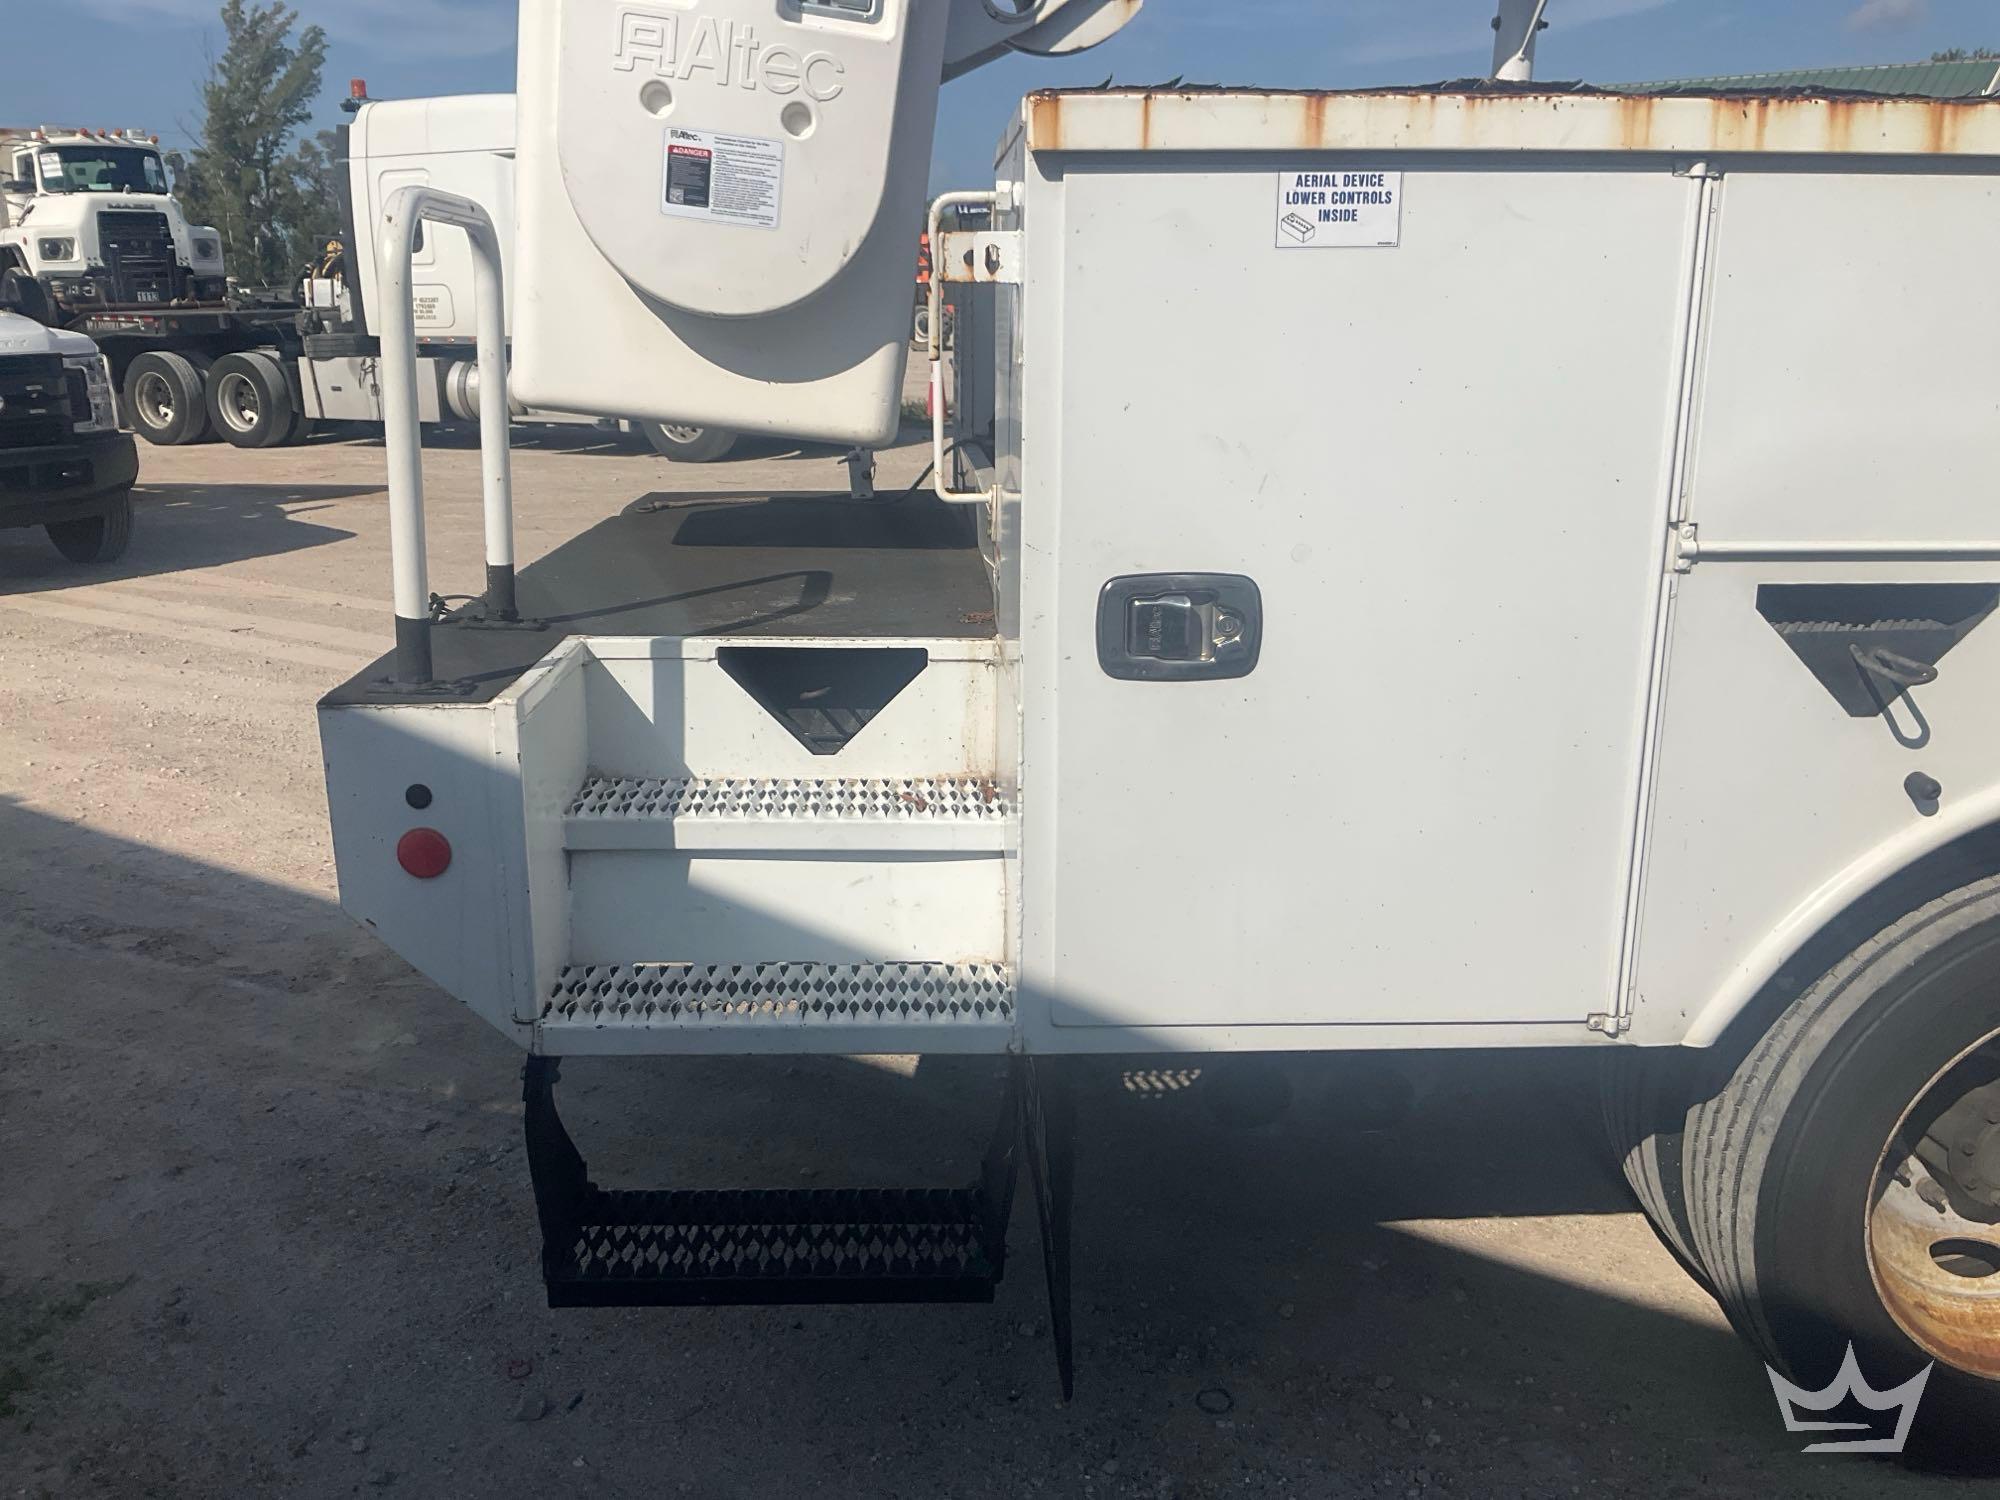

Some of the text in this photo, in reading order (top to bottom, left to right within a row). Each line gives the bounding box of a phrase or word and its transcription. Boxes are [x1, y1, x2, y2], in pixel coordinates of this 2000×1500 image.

[677, 16, 845, 102] Altec
[678, 147, 708, 158] DANGER
[1295, 174, 1385, 187] AERIAL DEVICE
[1286, 191, 1392, 205] LOWER CONTROLS
[1318, 208, 1358, 222] INSIDE
